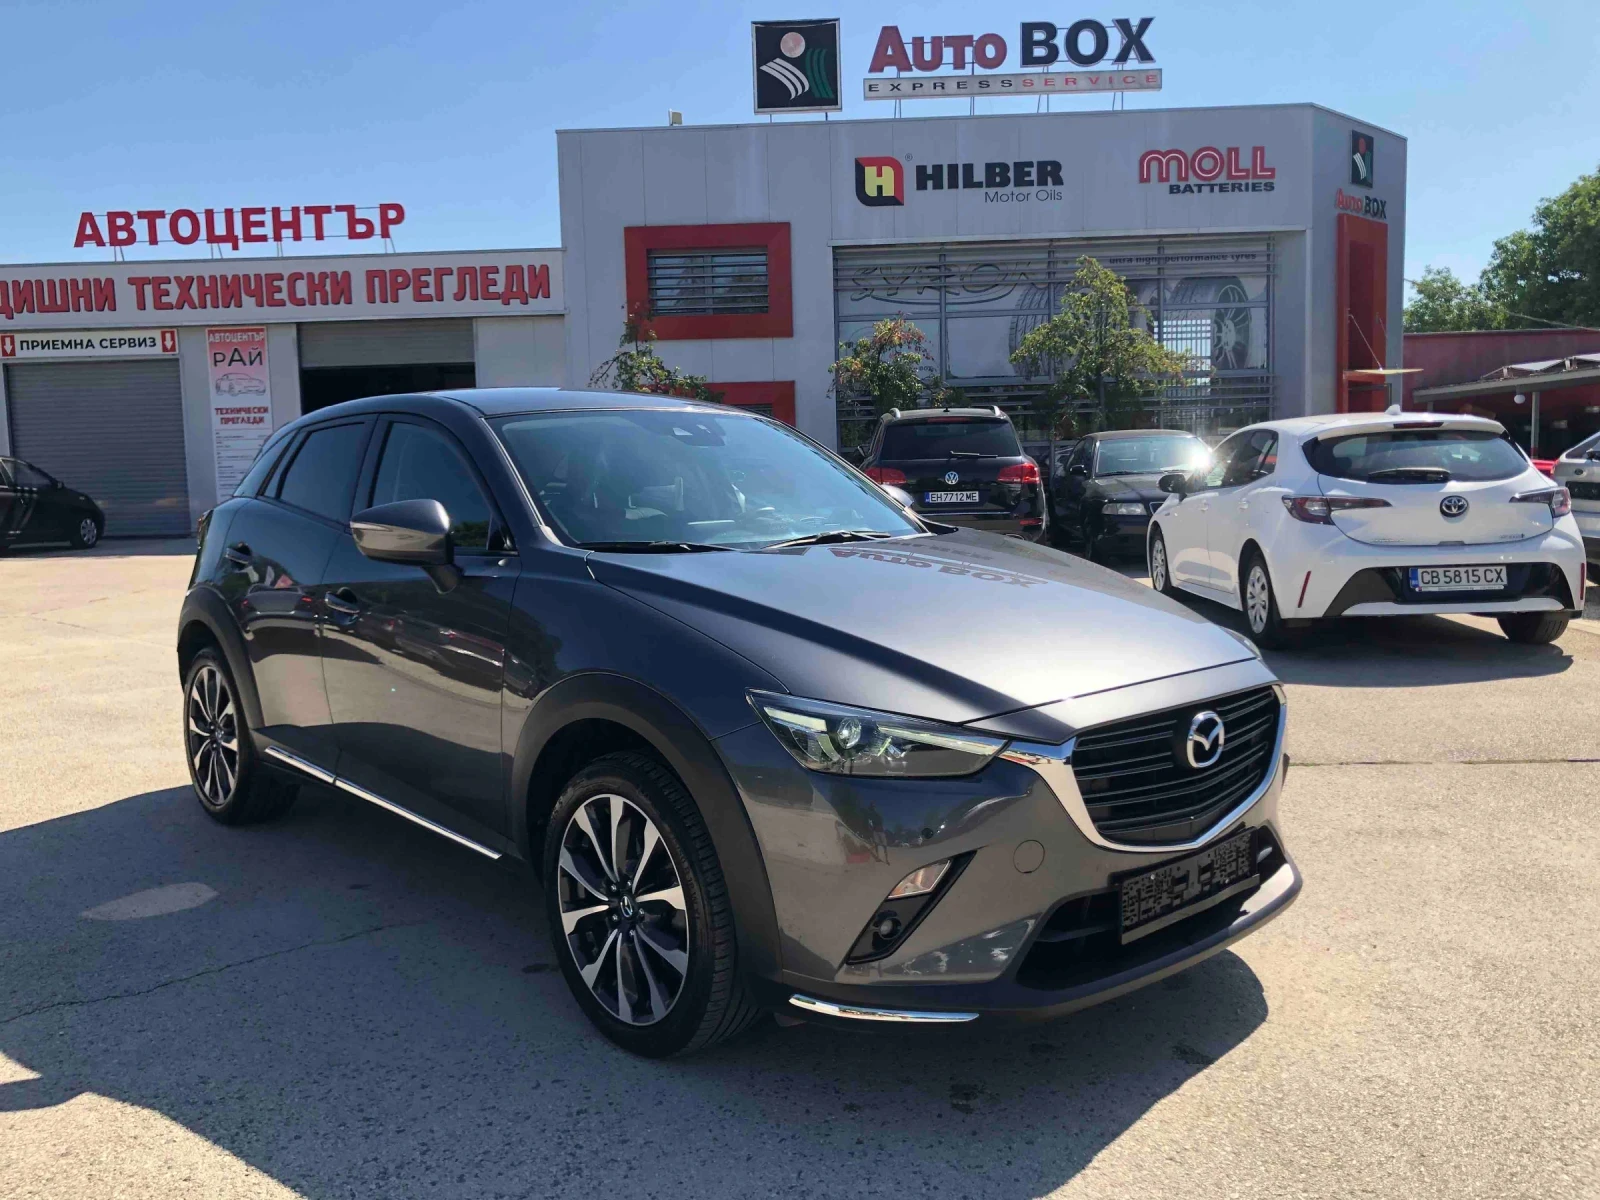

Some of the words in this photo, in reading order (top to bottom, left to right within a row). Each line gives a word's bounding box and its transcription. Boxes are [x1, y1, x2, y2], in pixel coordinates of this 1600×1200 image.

[1020, 16, 1156, 68] BOX
[916, 160, 1064, 191] HILBER
[1168, 181, 1275, 195] BATTERIES
[985, 191, 1031, 204] Motor
[1035, 189, 1063, 201] Oils
[1364, 195, 1387, 219] BOX
[74, 203, 405, 250] АВТОЦЕНТЪР
[127, 270, 352, 312] ТЕХНИЧЕСКИ
[365, 264, 551, 306] ПРЕГЛЕДИ
[20, 340, 95, 351] ПРИЕМНА
[100, 337, 156, 348] СЕРВИЗ
[208, 332, 264, 342] АВТОЦЕНТЪР
[214, 406, 269, 415] ТЕХНИЧЕСКИ
[220, 416, 265, 425] ПРЕГЛЕДИ
